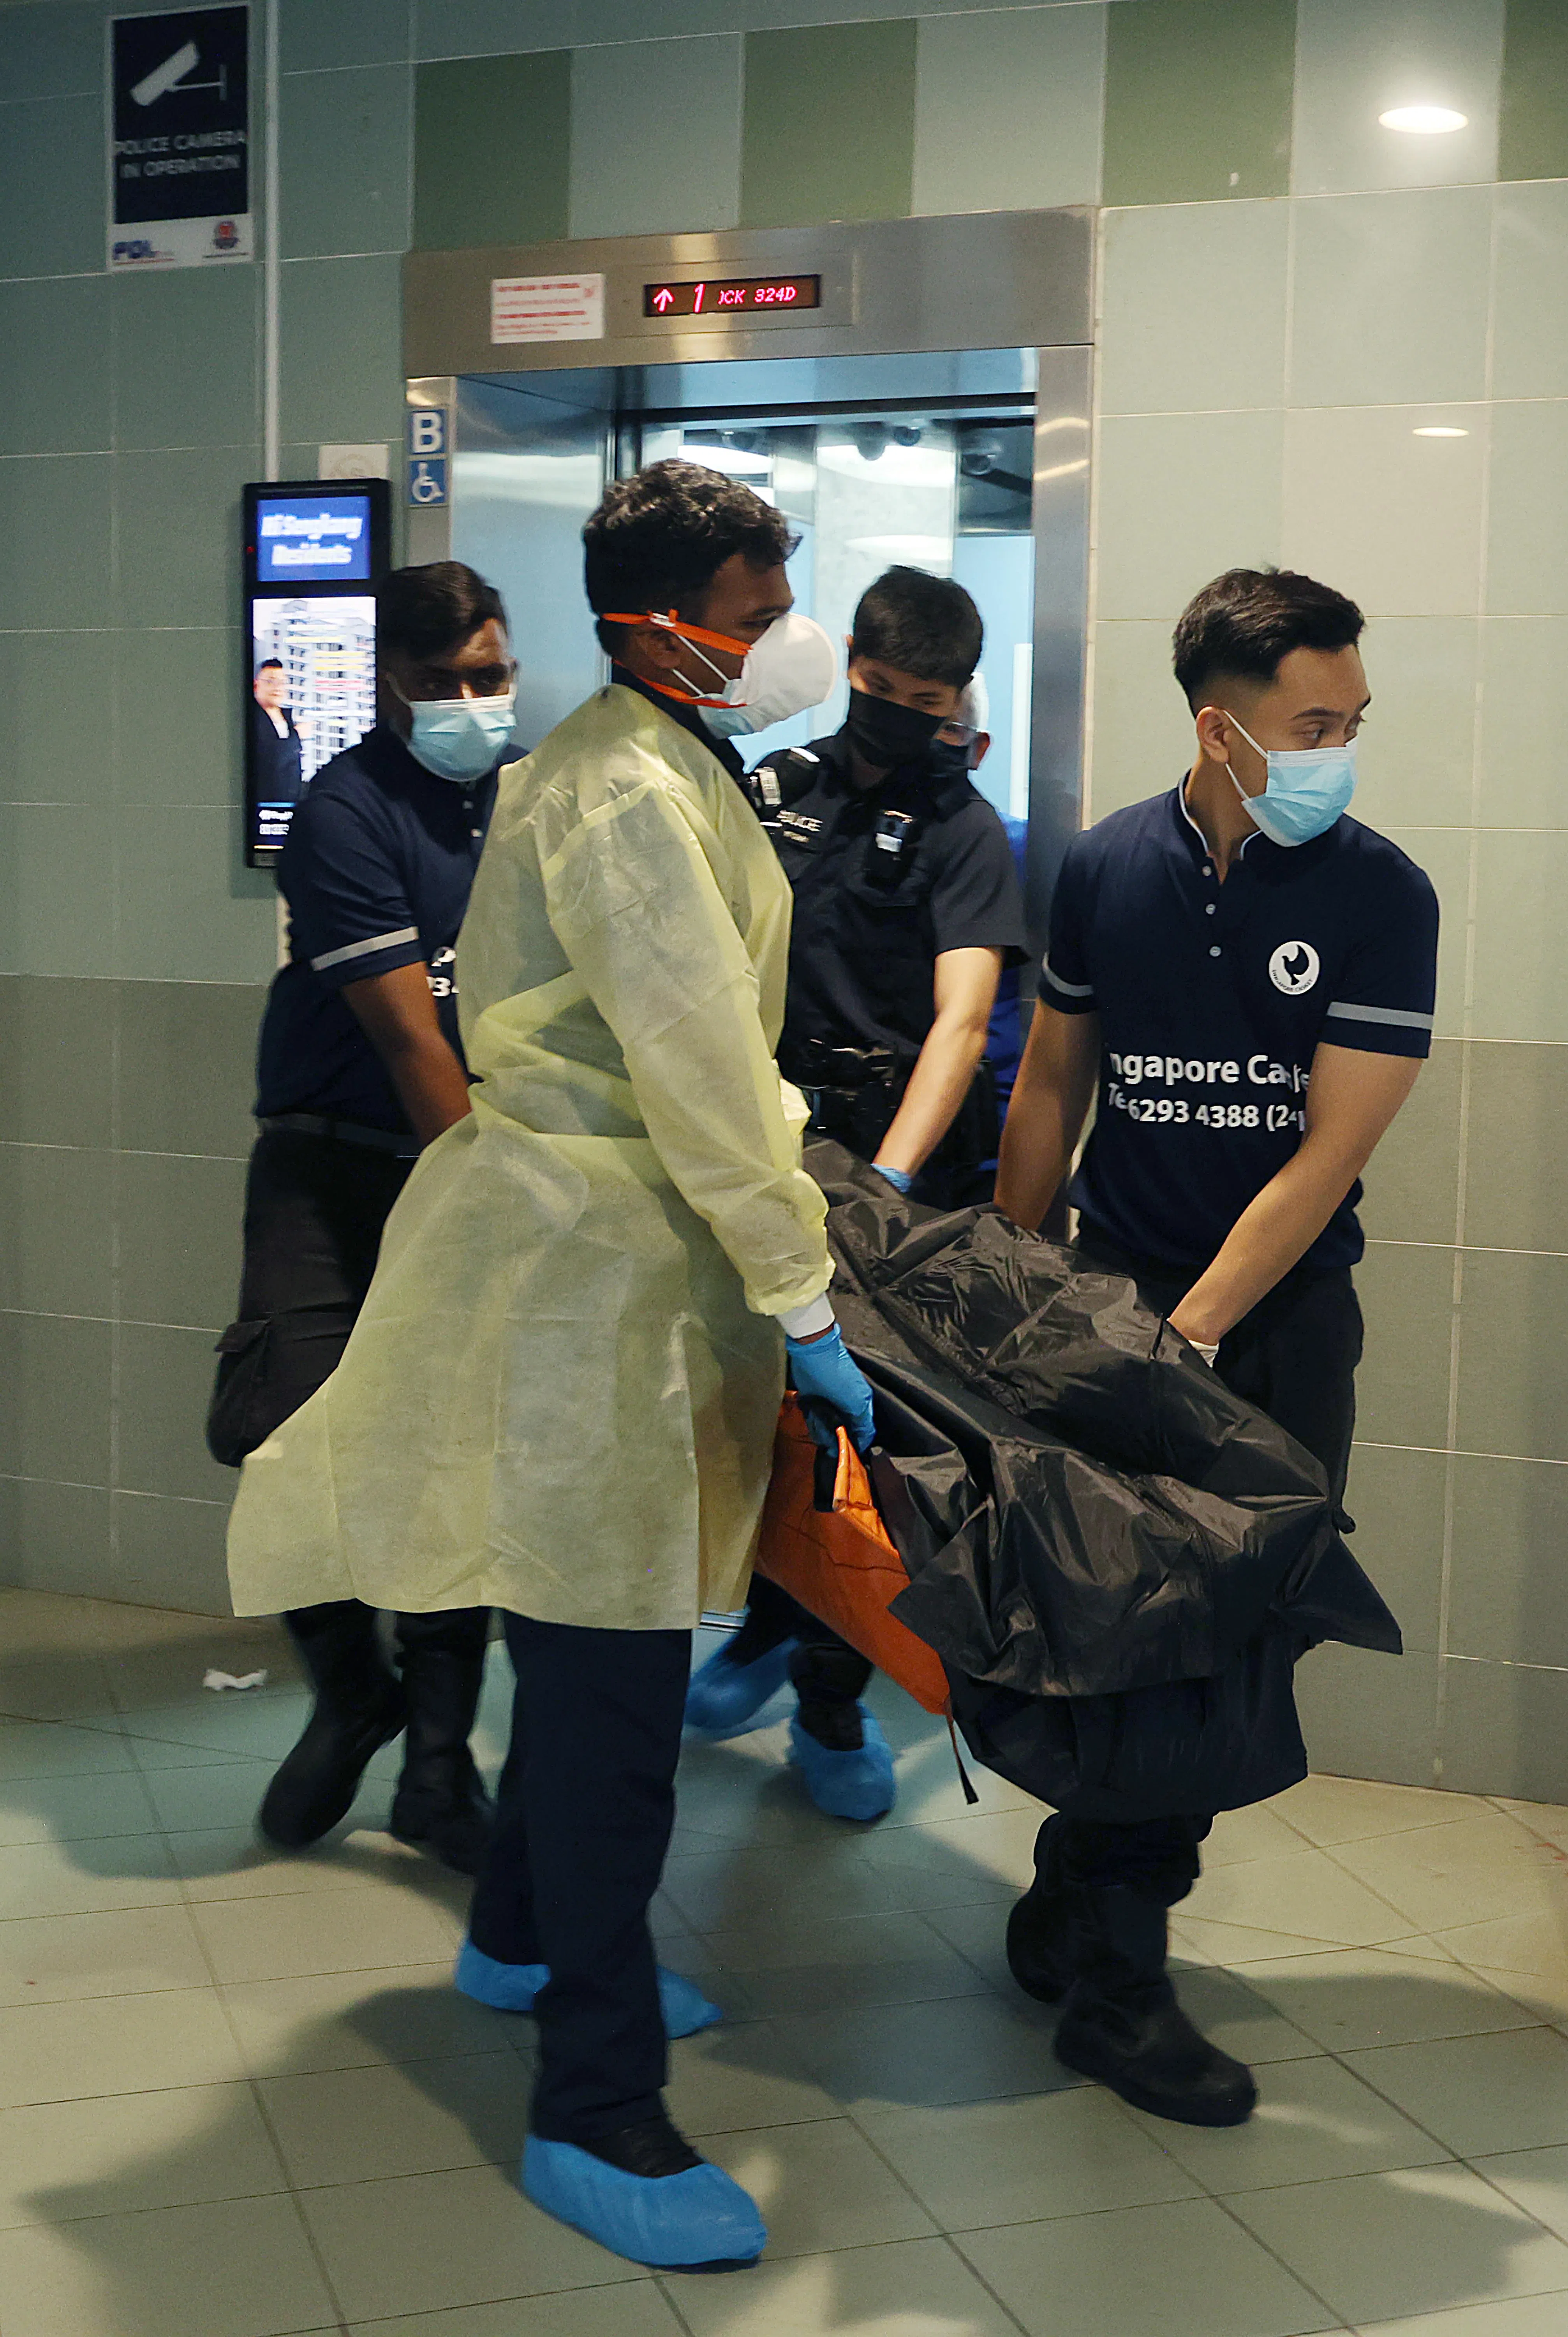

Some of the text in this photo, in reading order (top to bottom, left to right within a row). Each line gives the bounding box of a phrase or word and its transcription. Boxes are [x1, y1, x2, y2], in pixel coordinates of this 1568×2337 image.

[114, 130, 246, 155] POLICE CAMERA
[119, 155, 241, 179] IN OPERATION
[694, 283, 706, 313] 1
[413, 412, 442, 453] B
[1128, 1098, 1190, 1123] 6293
[1194, 1105, 1260, 1128] 4388
